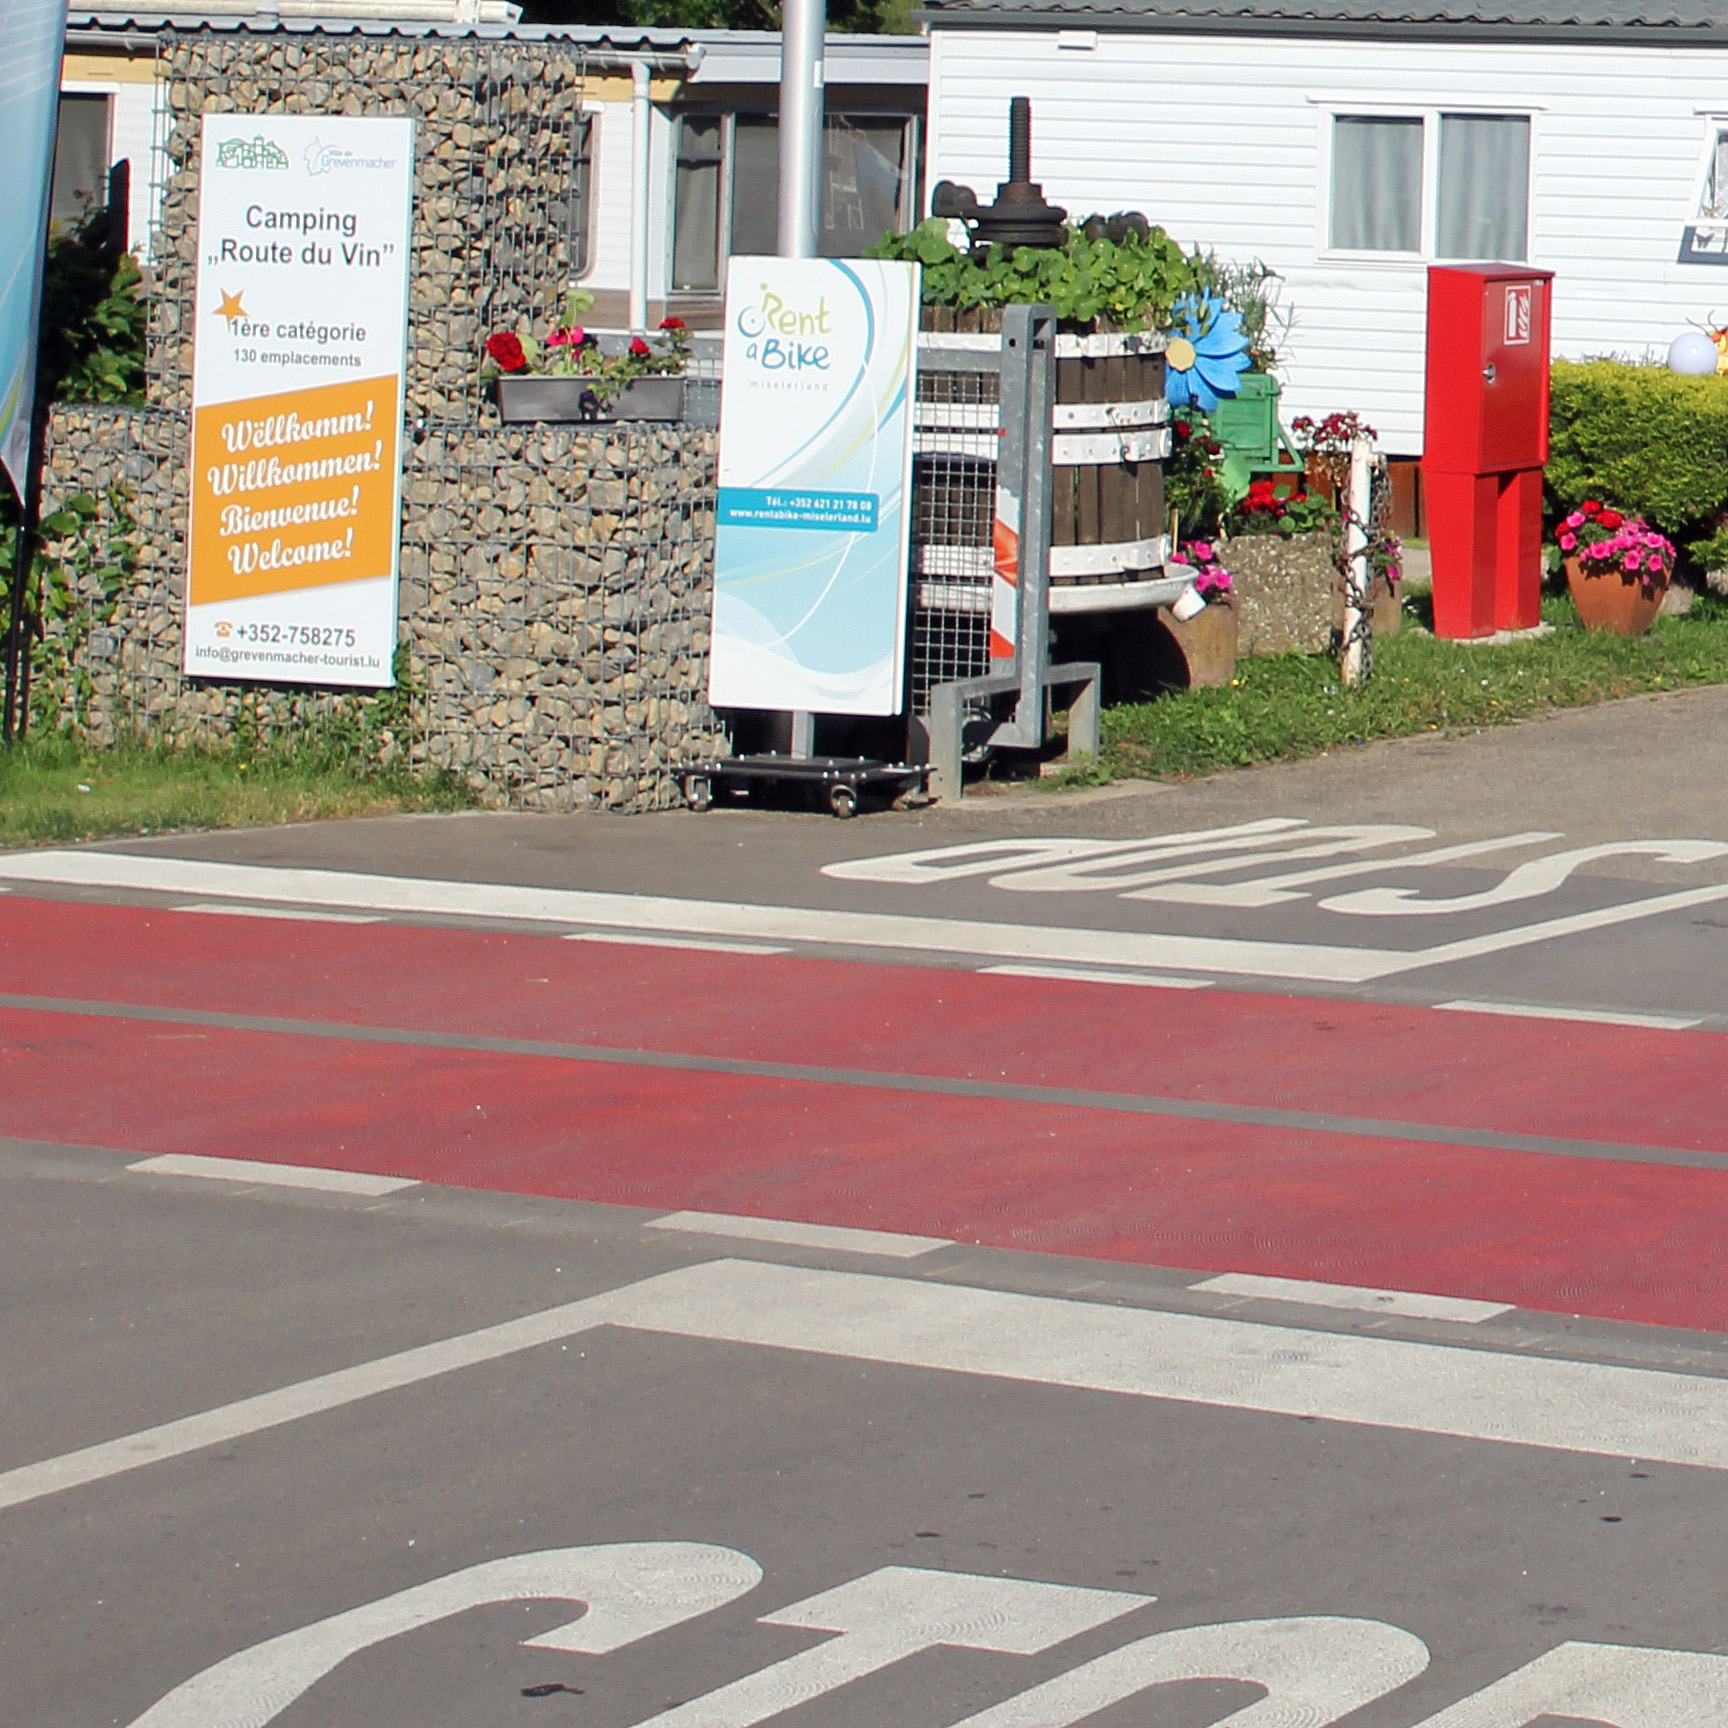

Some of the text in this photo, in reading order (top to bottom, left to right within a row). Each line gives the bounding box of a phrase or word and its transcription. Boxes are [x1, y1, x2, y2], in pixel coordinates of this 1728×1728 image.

[245, 204, 357, 237] Camping
[301, 241, 332, 265] du
[761, 291, 833, 336] Rent
[231, 319, 367, 345] 1ère catégorie
[233, 348, 362, 368] 130 emplacements
[745, 337, 832, 371] a Bike
[221, 399, 375, 454] Wëllkomm!
[207, 439, 384, 496] Willkommen!
[219, 485, 361, 537] Bienvenue!
[833, 499, 845, 511] 21
[227, 526, 355, 575] Welcome!
[236, 622, 357, 648] +352-758275
[195, 644, 381, 669] info@grevenmacher-tourist.lu
